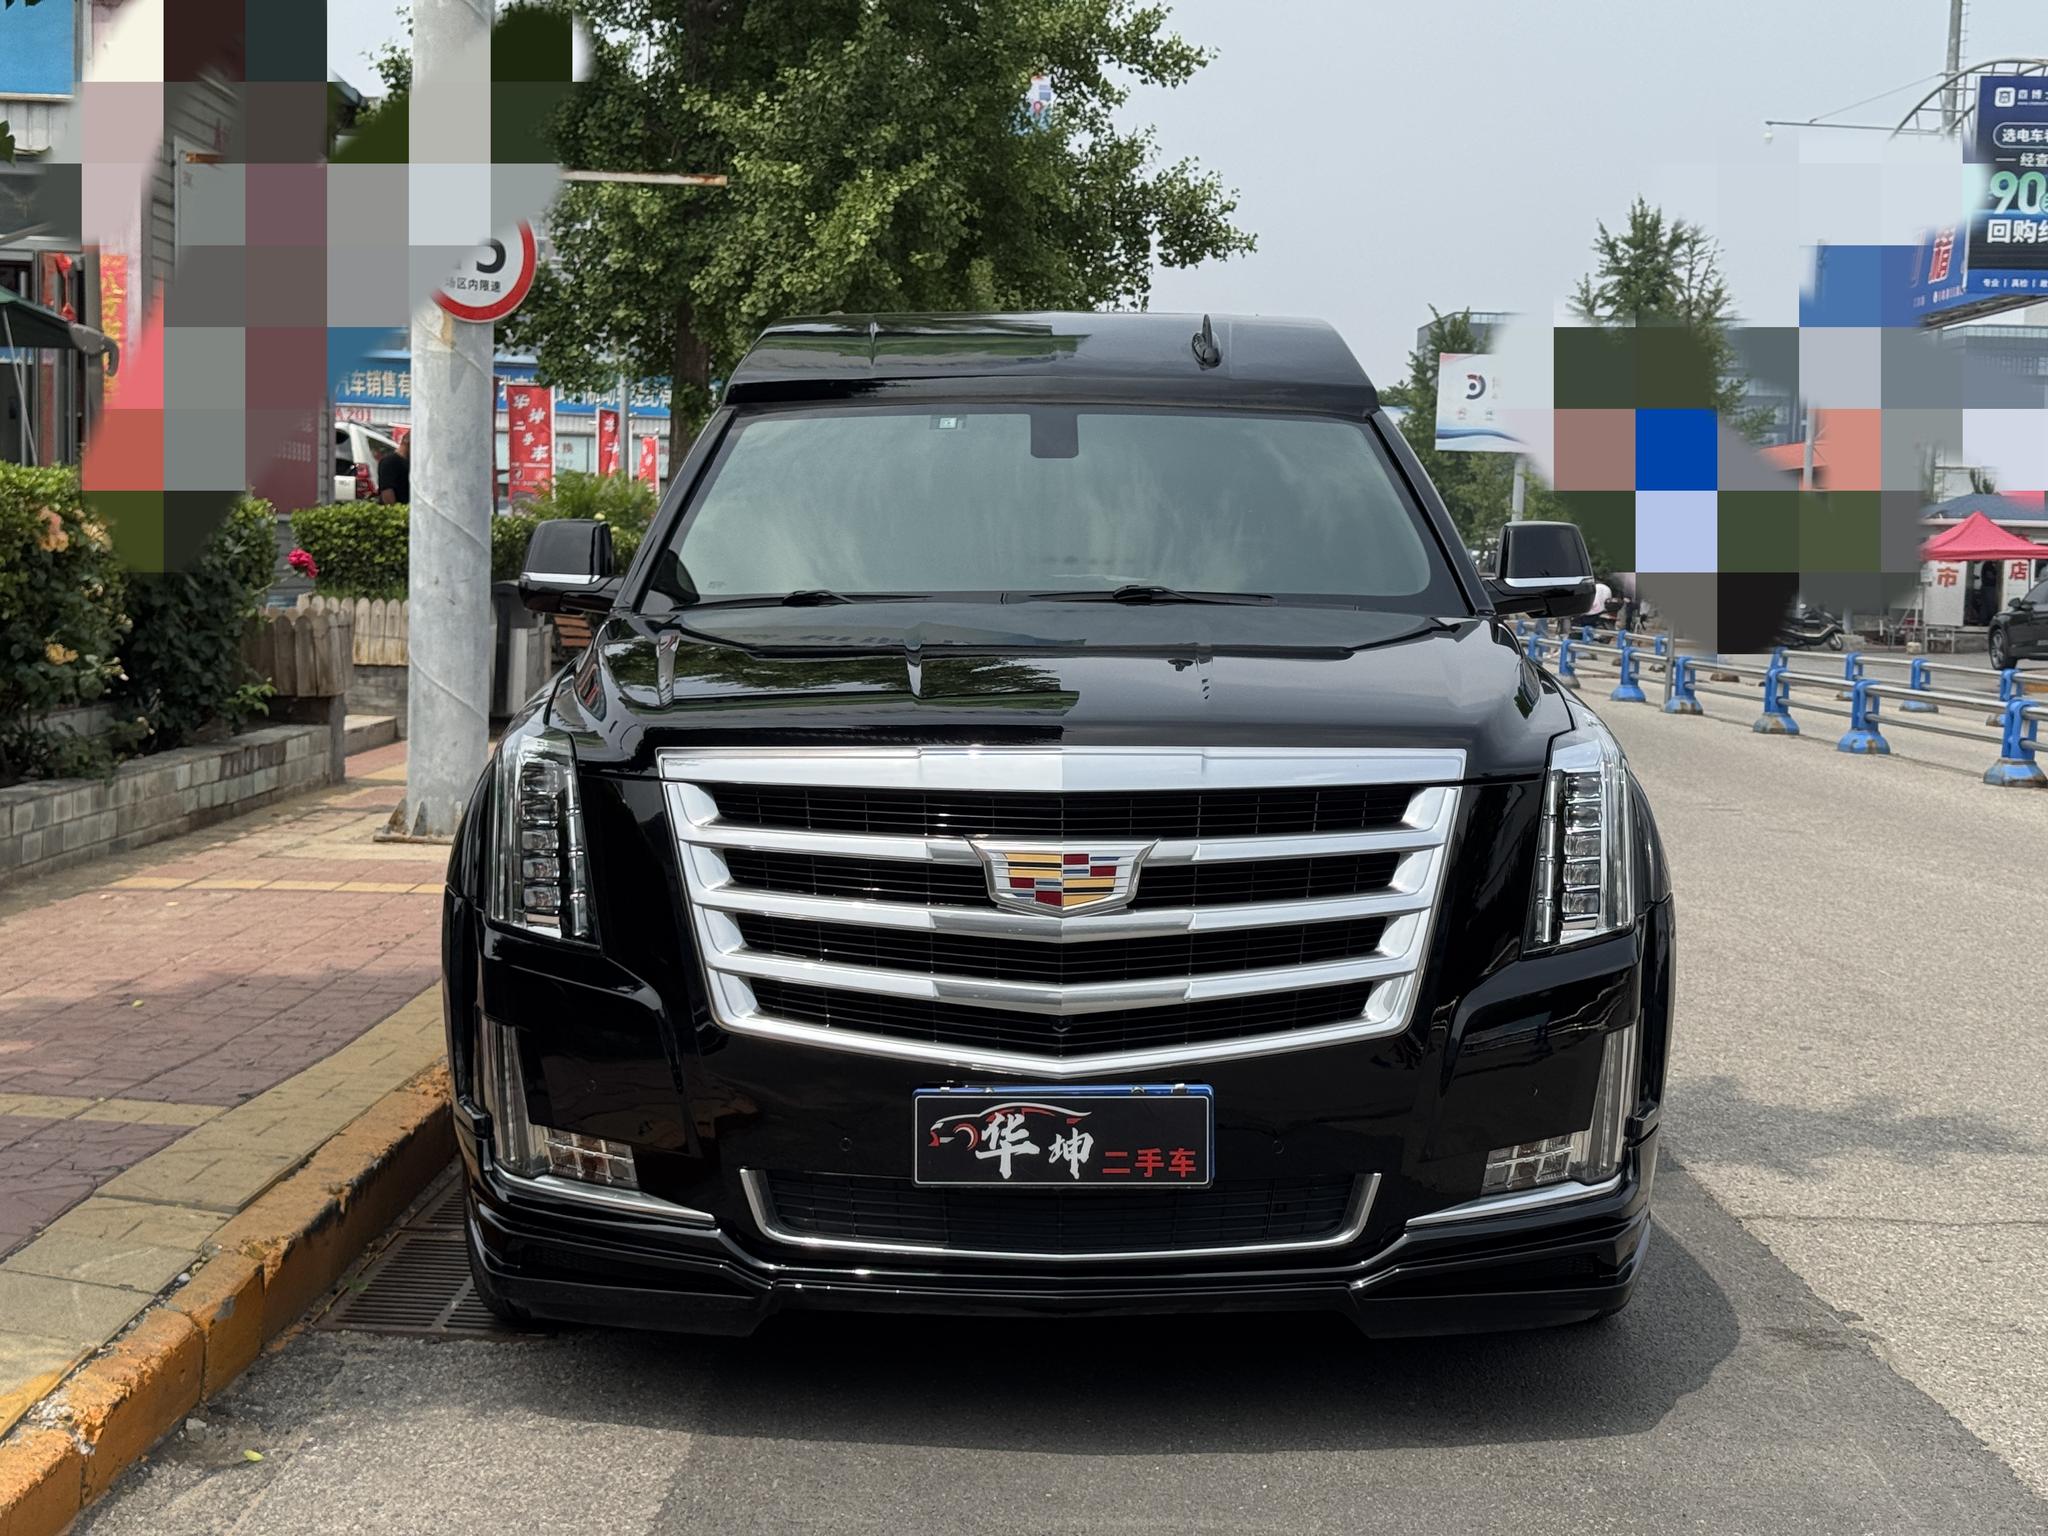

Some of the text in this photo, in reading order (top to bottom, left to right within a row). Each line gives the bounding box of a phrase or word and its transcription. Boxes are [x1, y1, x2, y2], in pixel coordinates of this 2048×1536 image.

[1990, 169, 2046, 215] 90
[1936, 567, 1959, 587] 市
[2009, 562, 2028, 580] 店
[975, 1112, 1197, 1180] 华坤 二手车
